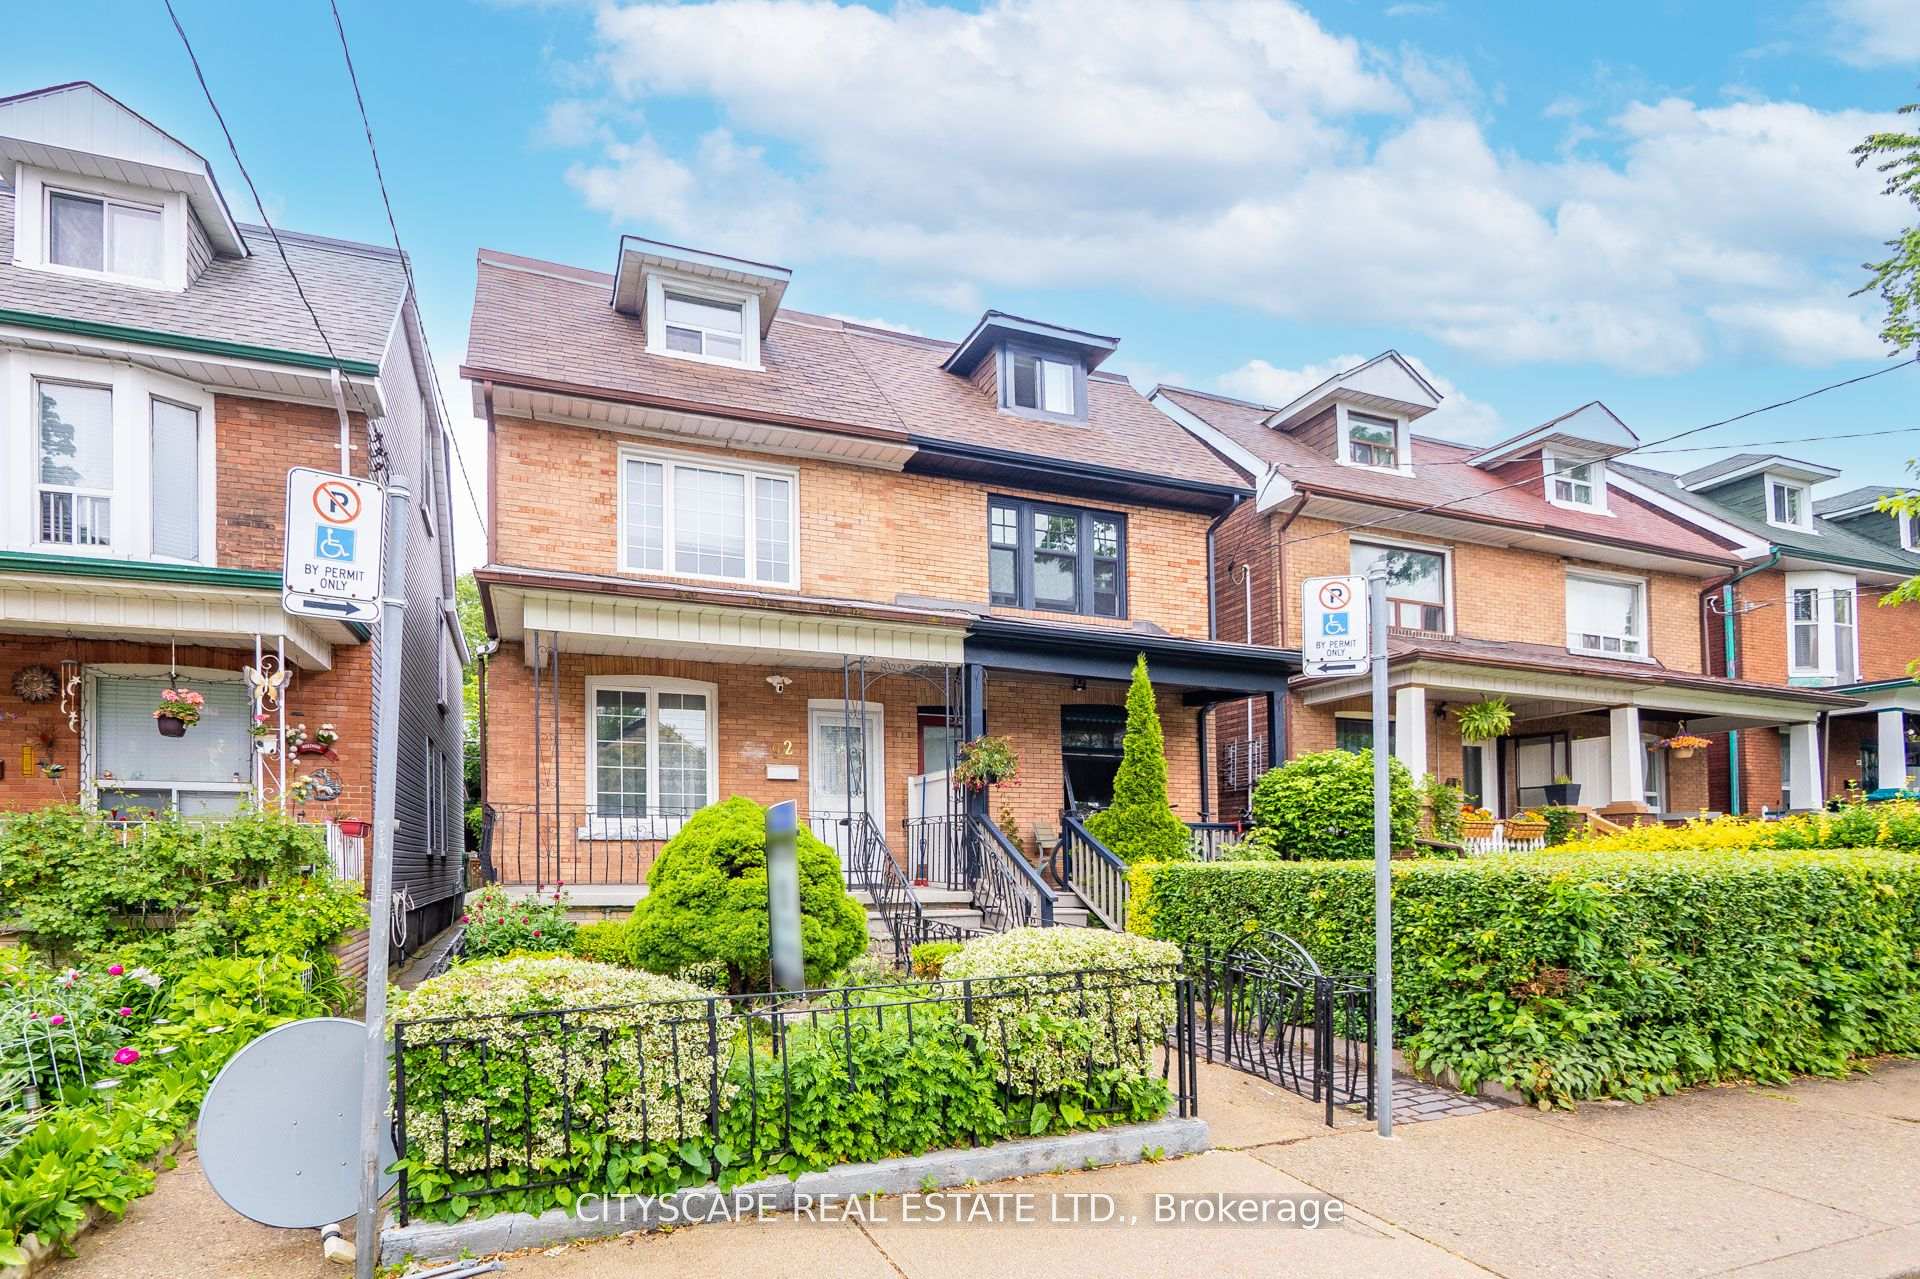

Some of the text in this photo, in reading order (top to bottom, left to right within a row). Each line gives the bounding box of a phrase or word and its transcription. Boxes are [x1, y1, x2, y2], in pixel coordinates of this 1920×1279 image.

[330, 491, 349, 513] P
[304, 564, 365, 582] BY PERMIT
[320, 578, 348, 591] ONLY
[1329, 588, 1343, 603] P
[1315, 640, 1357, 649] BY PERMIT
[1326, 649, 1346, 657] ONLY
